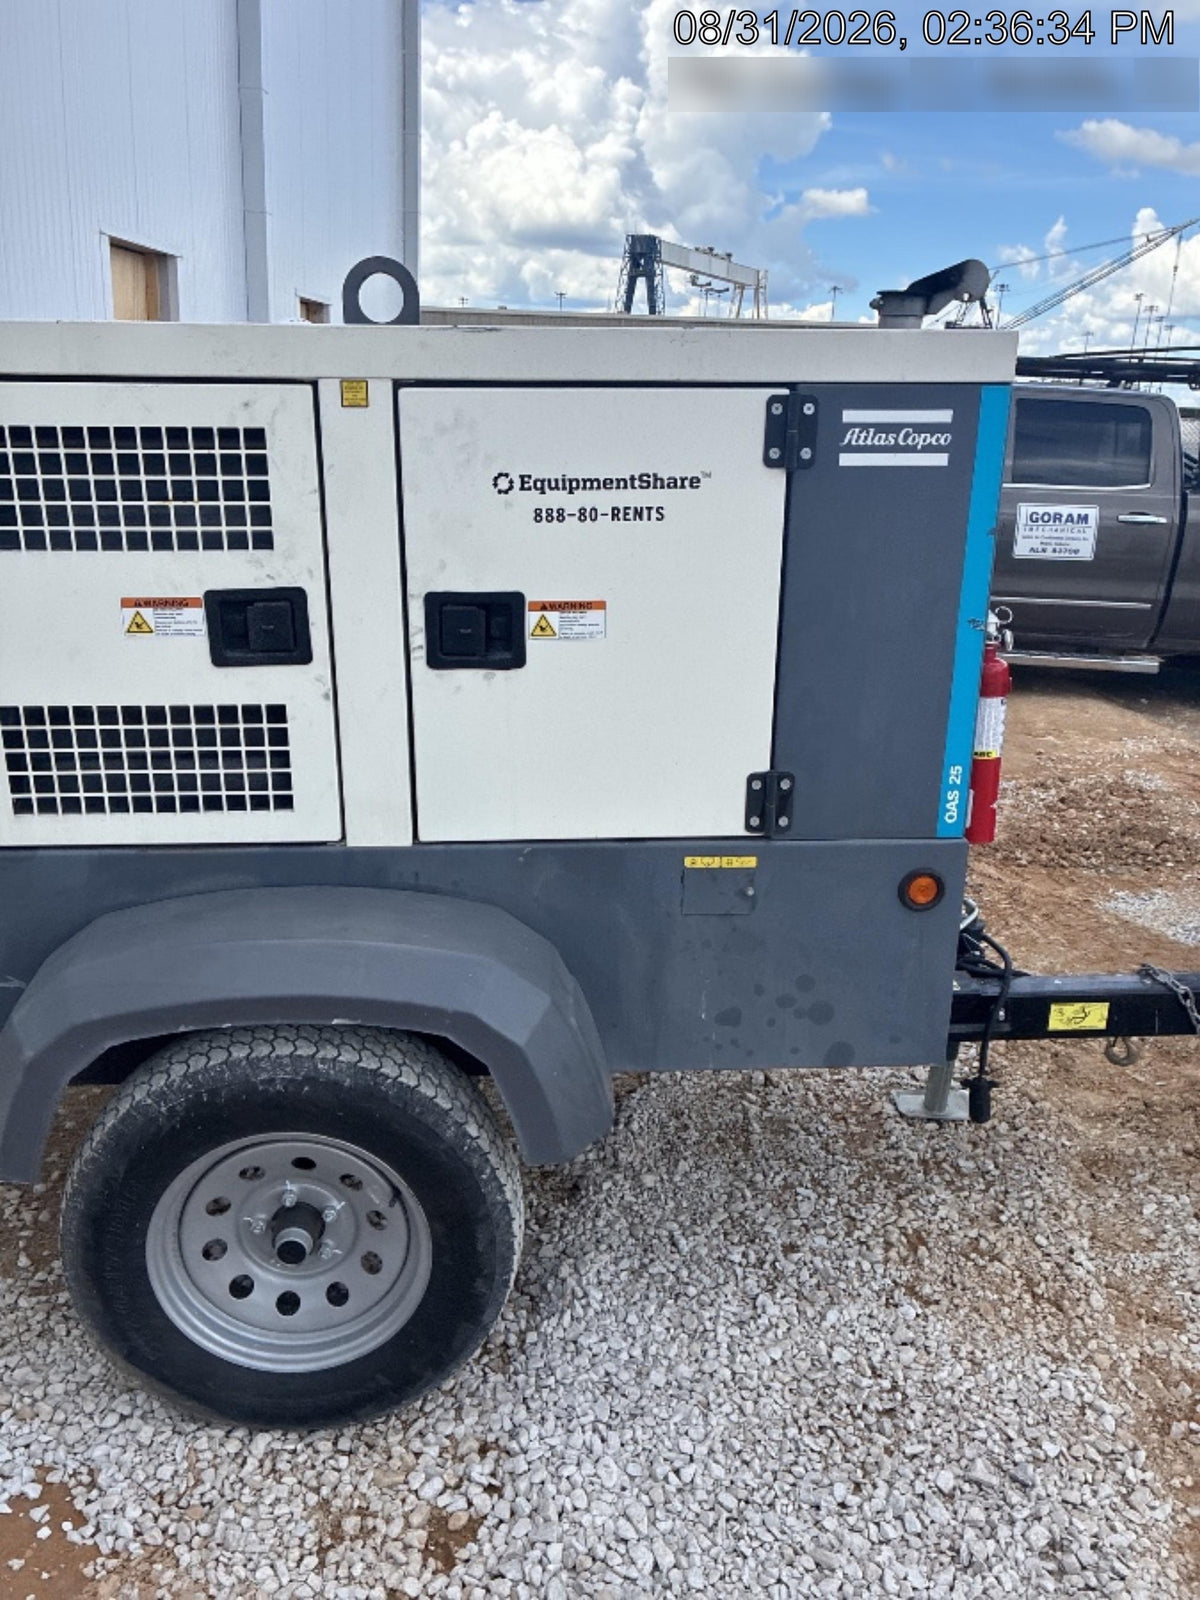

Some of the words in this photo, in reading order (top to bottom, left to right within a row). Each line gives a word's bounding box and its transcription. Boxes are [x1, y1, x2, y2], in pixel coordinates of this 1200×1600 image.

[839, 428, 896, 446] Atlas
[897, 428, 952, 450] Copco
[518, 472, 701, 495] EquipmentShare
[533, 506, 665, 523] 888-80-RENTS
[1029, 511, 1089, 525] GORAM
[549, 602, 593, 610] WARNING
[949, 765, 963, 785] 25
[944, 790, 960, 823] QAS
